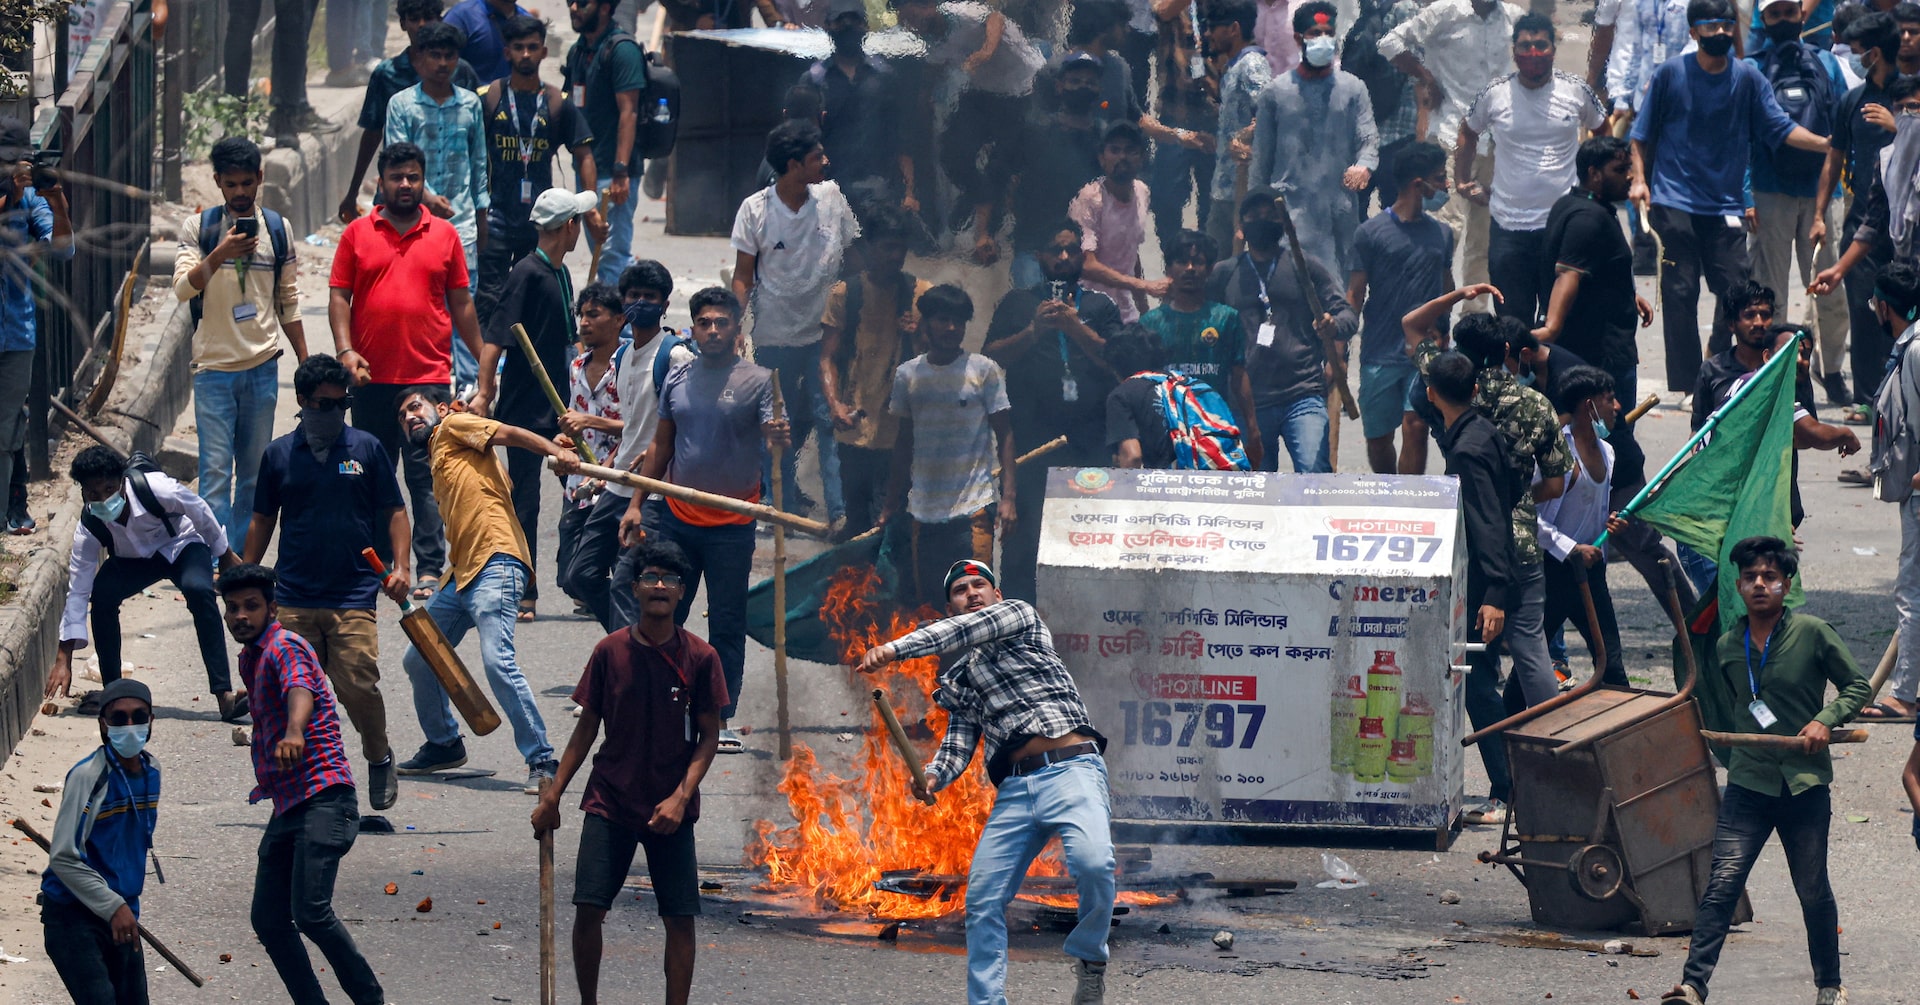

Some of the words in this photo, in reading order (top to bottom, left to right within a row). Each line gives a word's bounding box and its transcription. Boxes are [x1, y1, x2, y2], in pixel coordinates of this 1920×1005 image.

[495, 133, 549, 149] Emiates
[1136, 471, 1183, 486] পুলিশ
[1188, 475, 1223, 486] চেক
[1136, 486, 1161, 495] ঢাকা
[1165, 485, 1229, 497] মেট্রোপলিটন
[1233, 487, 1265, 499] পুলিশ
[1071, 513, 1118, 524] ওমেরা
[1125, 513, 1191, 526] এলপিজি
[1197, 515, 1264, 530] সিলিন্ডার
[1347, 521, 1423, 533] HOTLINE
[1068, 530, 1115, 547] হোম
[1122, 530, 1225, 549] ডেলিভারি
[1228, 539, 1267, 551] পেতে
[1312, 535, 1443, 563] 16797
[1119, 552, 1150, 563] কল
[1224, 609, 1288, 630] সিলিন্ডার
[1208, 643, 1244, 659] পেতে
[1248, 644, 1280, 658] কল
[1159, 679, 1244, 695] HOTLINE
[1119, 701, 1267, 749] 16797
[1237, 773, 1265, 784] ৯০০
